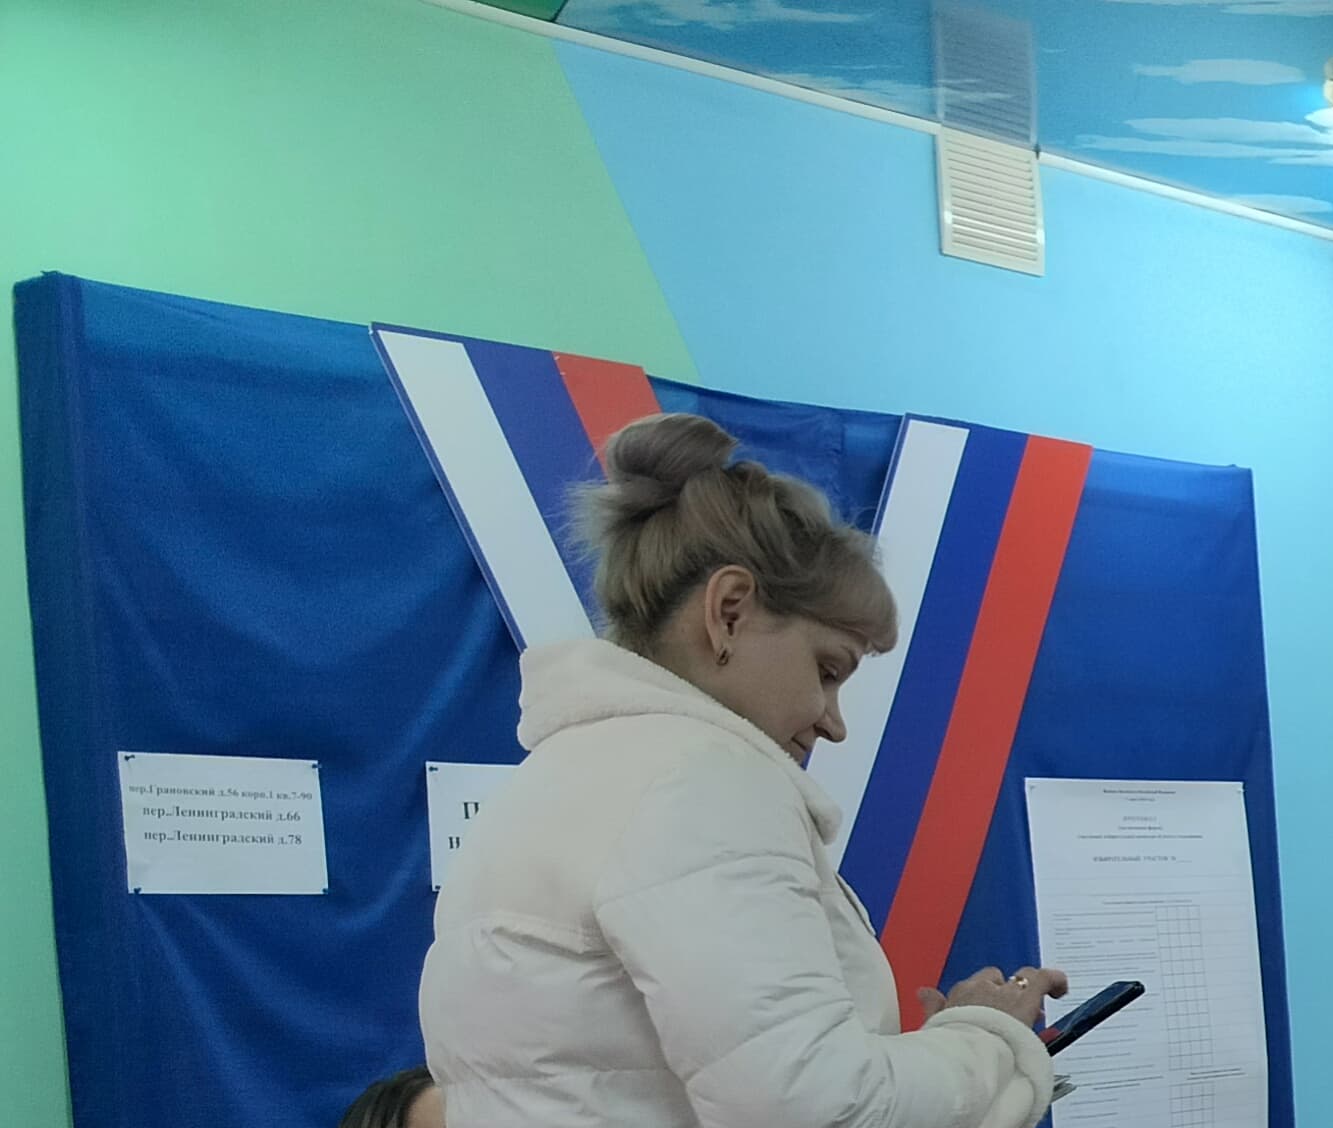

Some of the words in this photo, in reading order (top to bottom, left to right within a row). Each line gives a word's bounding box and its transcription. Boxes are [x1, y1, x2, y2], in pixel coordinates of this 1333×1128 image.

[143, 806, 273, 821] пер.Ленинградский
[276, 811, 301, 821] д.66
[144, 830, 274, 845] пер.Ленинградский
[277, 834, 302, 845] д.78
